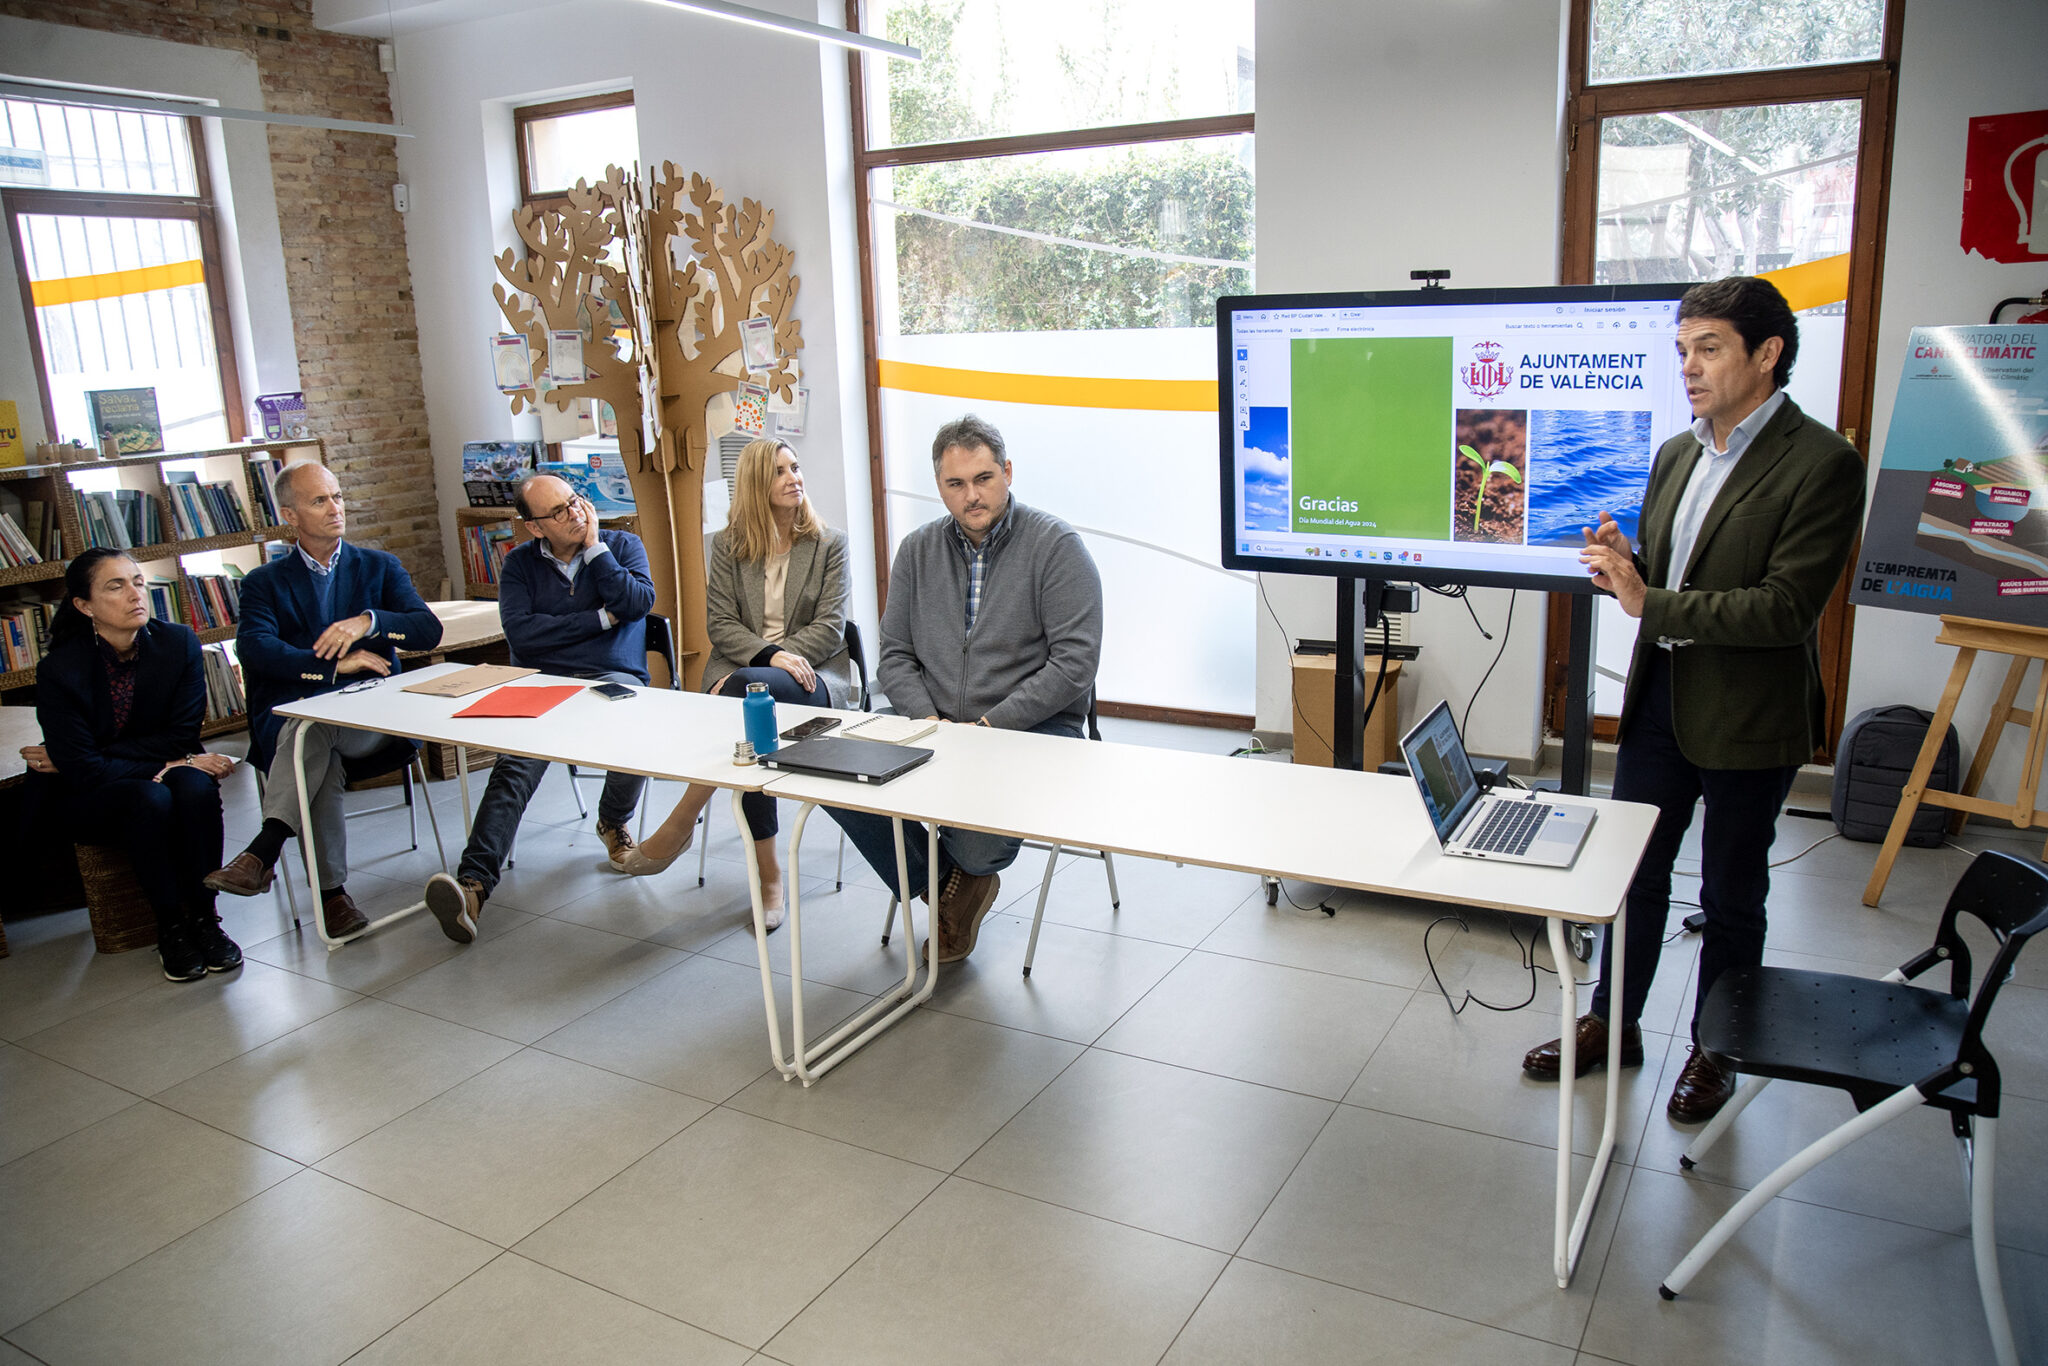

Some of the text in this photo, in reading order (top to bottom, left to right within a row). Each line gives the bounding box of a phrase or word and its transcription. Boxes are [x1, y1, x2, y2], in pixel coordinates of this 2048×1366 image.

[2011, 333, 2038, 345] DEL
[1965, 344, 2037, 359] CLIMÀTIC
[1519, 353, 1647, 369] AJUNTAMENT
[1520, 371, 1644, 389] DE VALÈNCIA
[1993, 488, 2027, 498] AIGUAMOLL
[1299, 495, 1359, 513] Gracias
[1298, 516, 1309, 524] Día
[1310, 517, 1334, 525] Mundial
[1335, 518, 1344, 526] del
[1345, 519, 1361, 528] Agua
[1974, 520, 2009, 528] INFILTRACIÓ
[1971, 527, 2011, 535] INFILTRACIÓN
[1865, 561, 1957, 582] L'EMPREMTA
[1861, 578, 1952, 602] DE L'AIGUA
